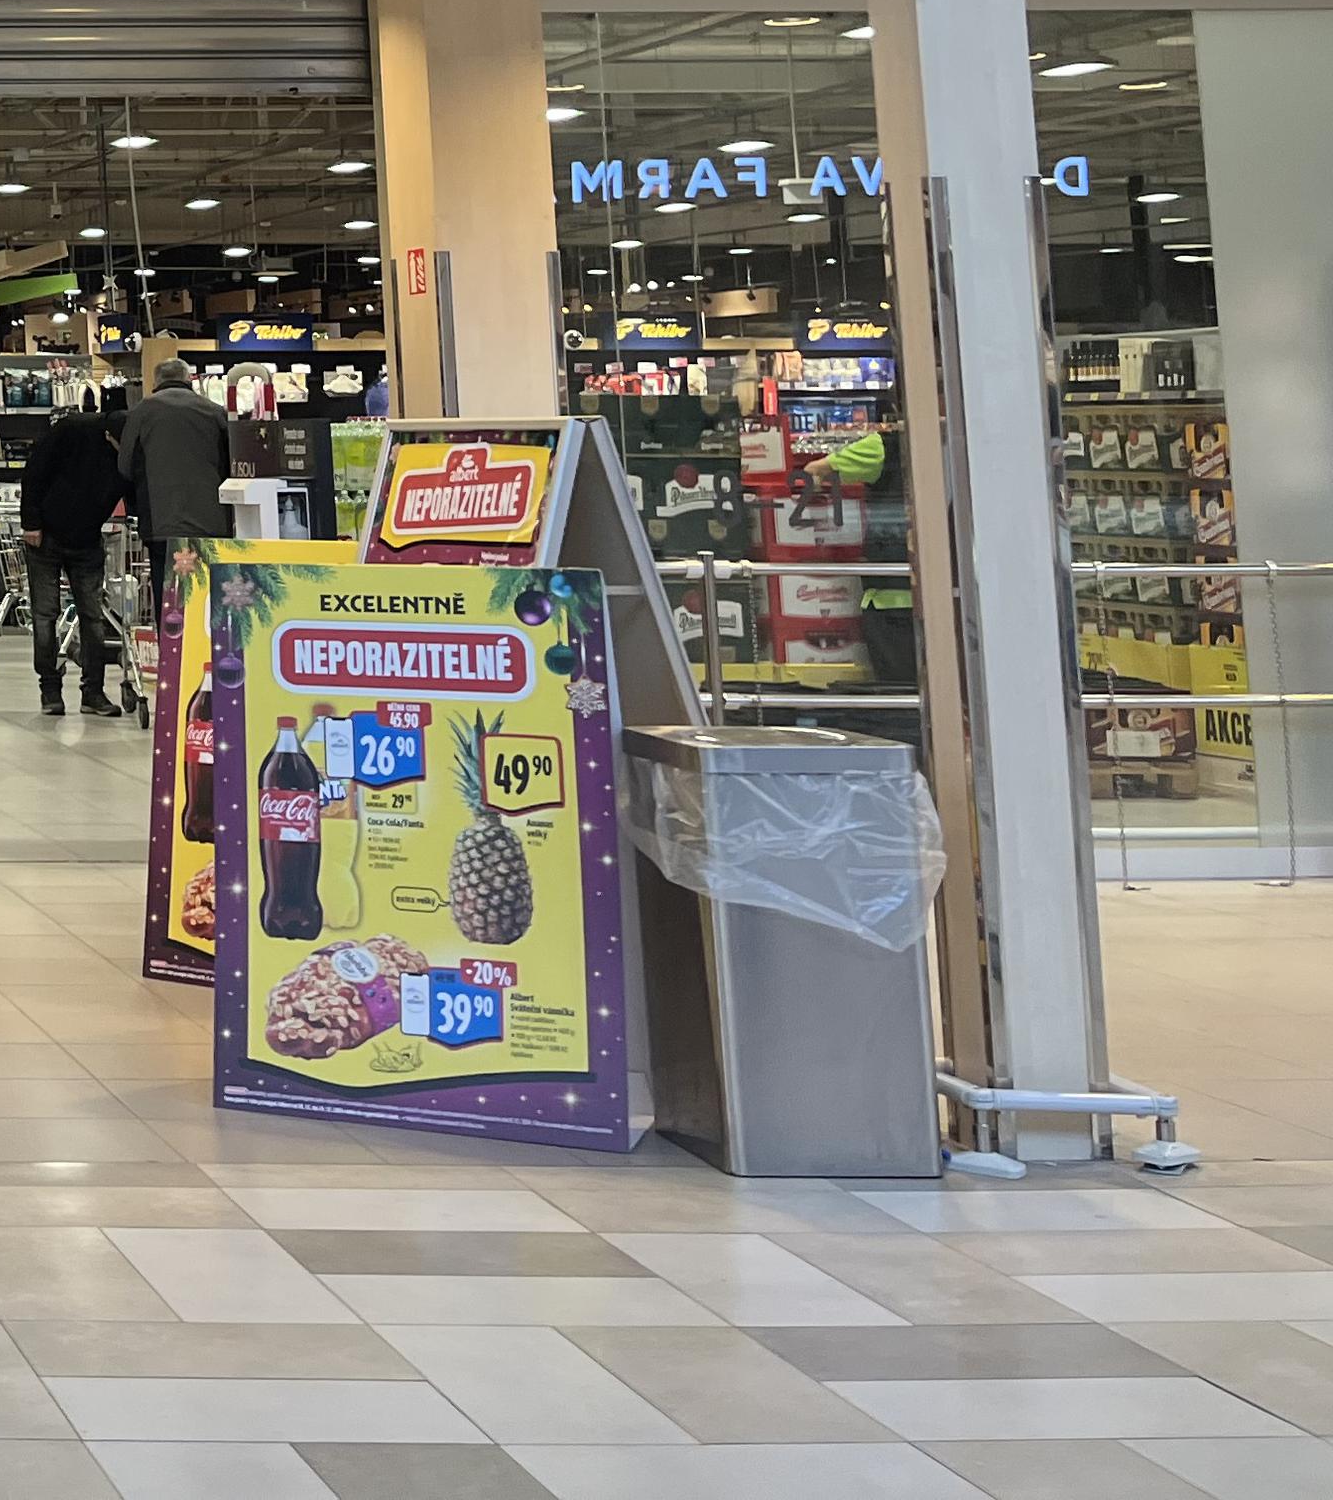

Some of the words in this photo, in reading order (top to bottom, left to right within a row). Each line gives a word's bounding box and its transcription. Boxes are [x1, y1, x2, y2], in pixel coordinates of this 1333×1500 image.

[254, 324, 306, 340] Tchibo
[449, 466, 480, 483] albert
[402, 473, 522, 523] NEPORAZITELNÉ
[319, 592, 466, 615] EXCELENTNĚ
[293, 636, 514, 681] NEPORAZITELNÉ
[319, 780, 346, 800] NTA
[465, 961, 512, 987] -20%
